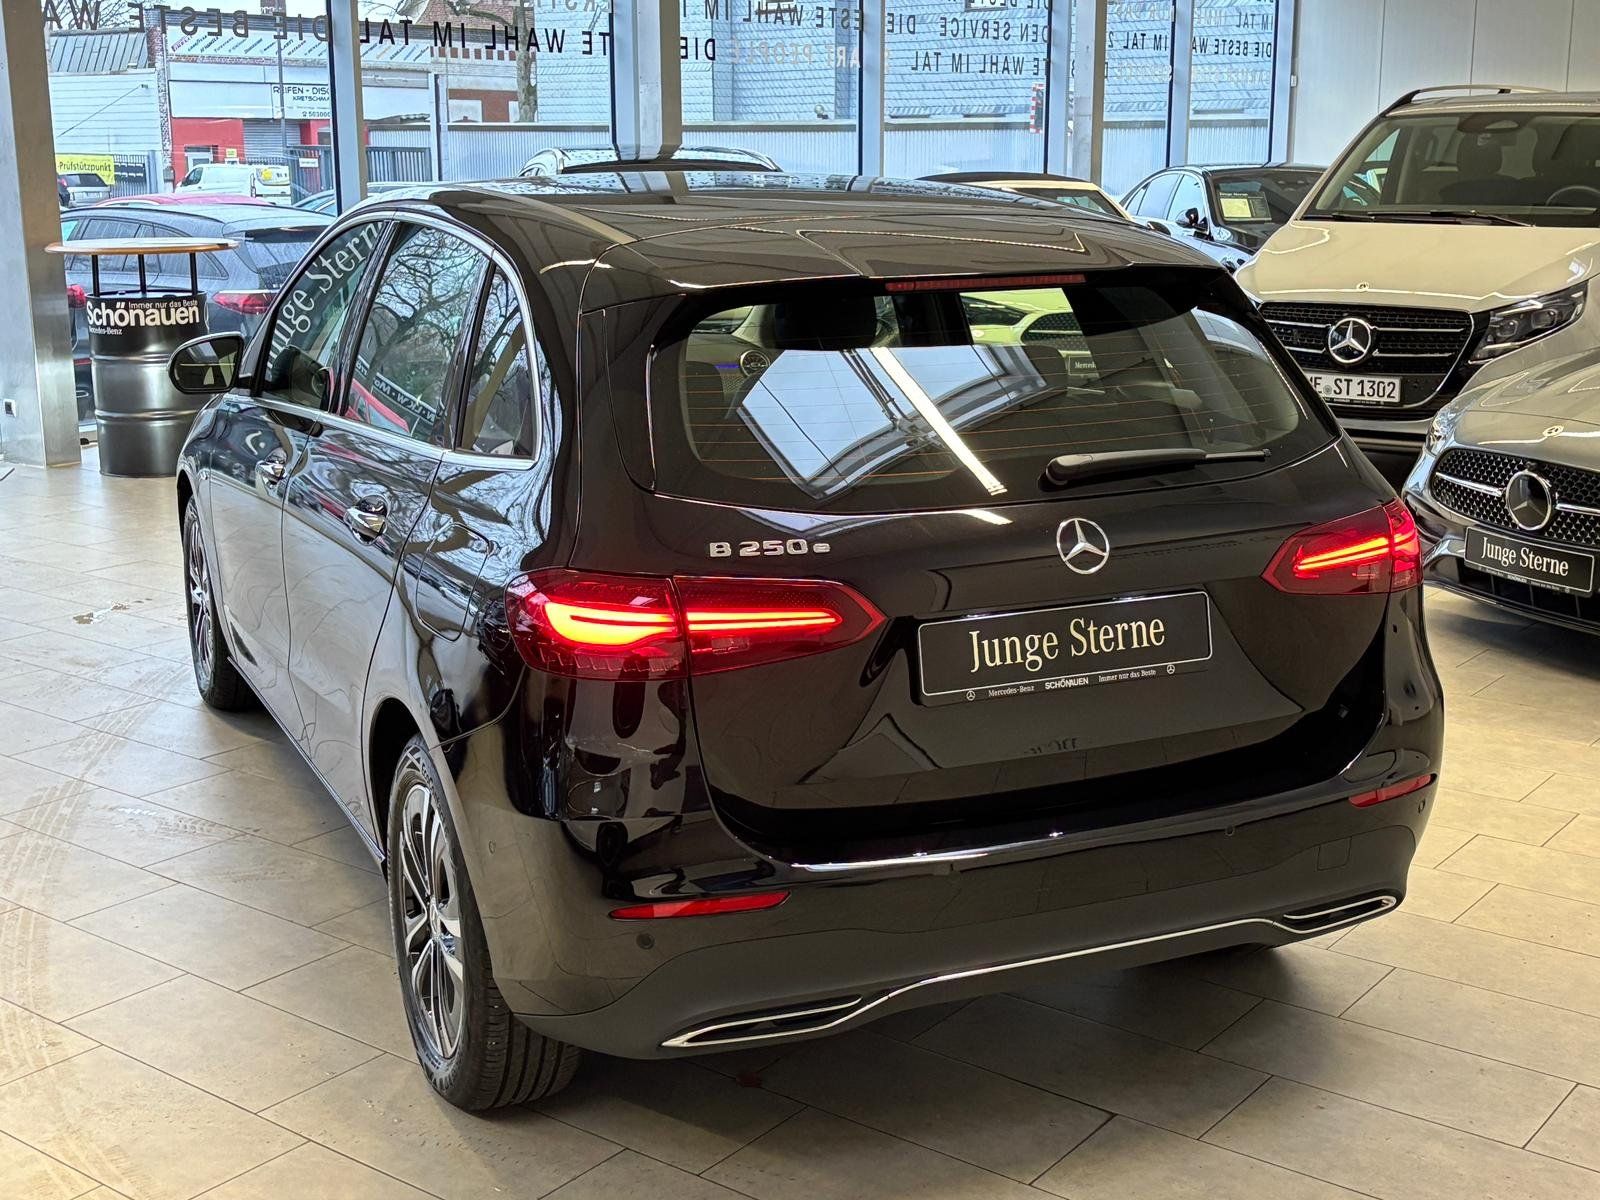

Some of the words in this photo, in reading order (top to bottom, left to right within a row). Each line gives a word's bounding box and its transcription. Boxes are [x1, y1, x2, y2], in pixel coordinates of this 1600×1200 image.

[273, 86, 304, 95] RIFEN
[86, 300, 200, 327] Schönauen
[128, 301, 153, 309] Immer
[169, 300, 181, 308] das
[182, 299, 198, 307] Beste
[266, 289, 315, 369] unge
[1333, 378, 1353, 396] ST
[1356, 380, 1396, 399] 1302
[709, 541, 732, 557] B
[1481, 536, 1517, 567] Junge
[1520, 547, 1569, 576] Sterne
[969, 630, 1059, 673] Junge
[1069, 616, 1165, 657] Sterne
[988, 685, 1035, 697] Mercedes-Benz
[1044, 677, 1089, 690] SCHÖNAUEN
[1098, 673, 1117, 683] Immer
[1118, 672, 1129, 681] nur
[1129, 671, 1140, 679] das
[1141, 669, 1156, 678] Beste
